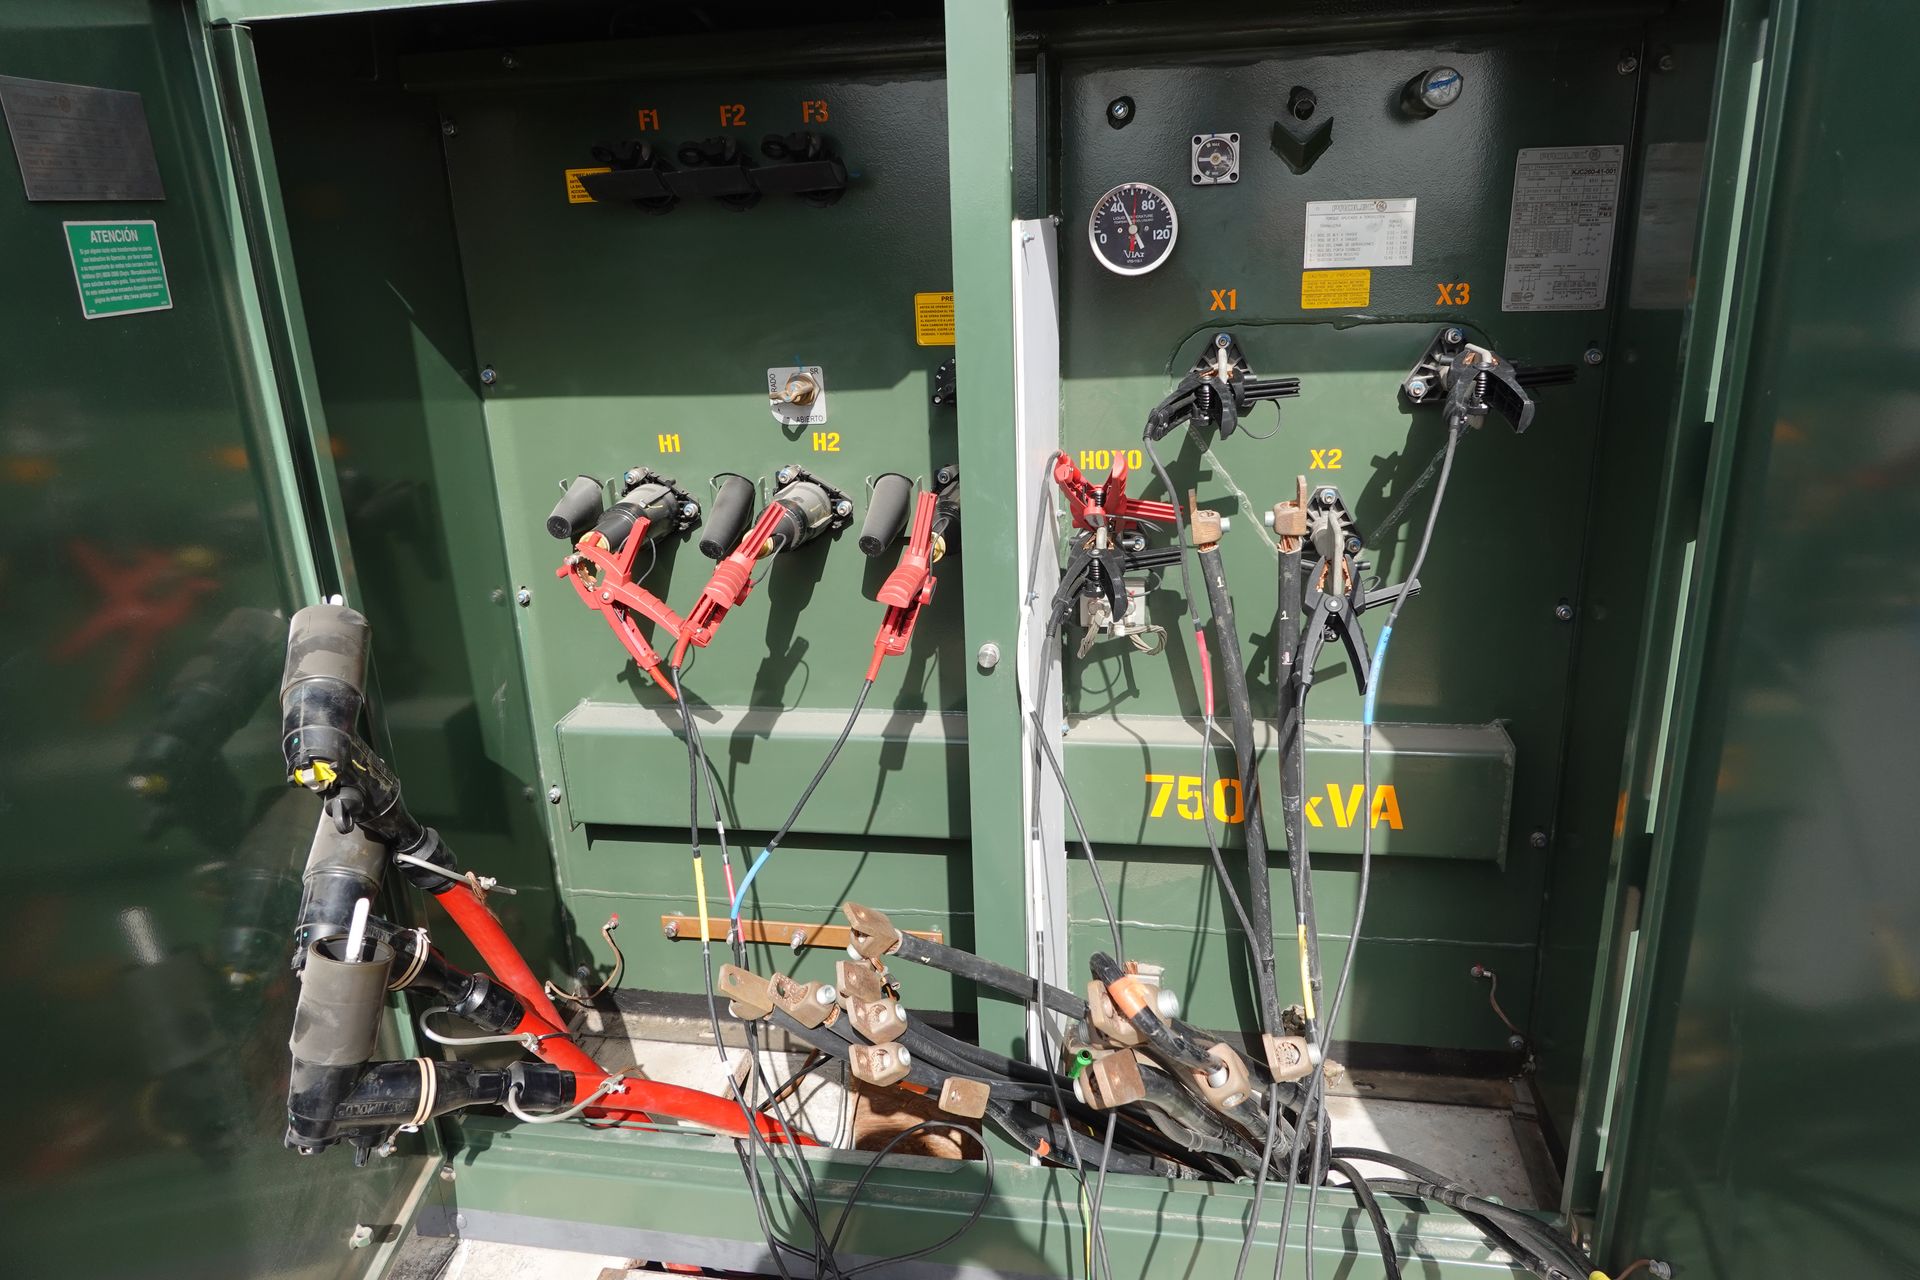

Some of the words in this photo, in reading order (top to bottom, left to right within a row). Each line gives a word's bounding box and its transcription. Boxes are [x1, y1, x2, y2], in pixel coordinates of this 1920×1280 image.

[638, 109, 660, 131] F1
[719, 104, 747, 127] F2
[802, 100, 830, 123] F3
[1110, 203, 1125, 213] 40
[1141, 200, 1155, 211] 80
[90, 226, 139, 243] ATENCIÓN
[1100, 234, 1107, 244] 0
[1152, 228, 1171, 241] 120
[1210, 288, 1237, 312] X1
[1435, 282, 1470, 307] X3
[796, 415, 824, 423] ABIERTO
[657, 434, 681, 453] H1
[812, 432, 841, 452] H2
[1311, 449, 1343, 469] X2
[1145, 773, 1244, 824] 750
[1304, 783, 1404, 830] kVA
